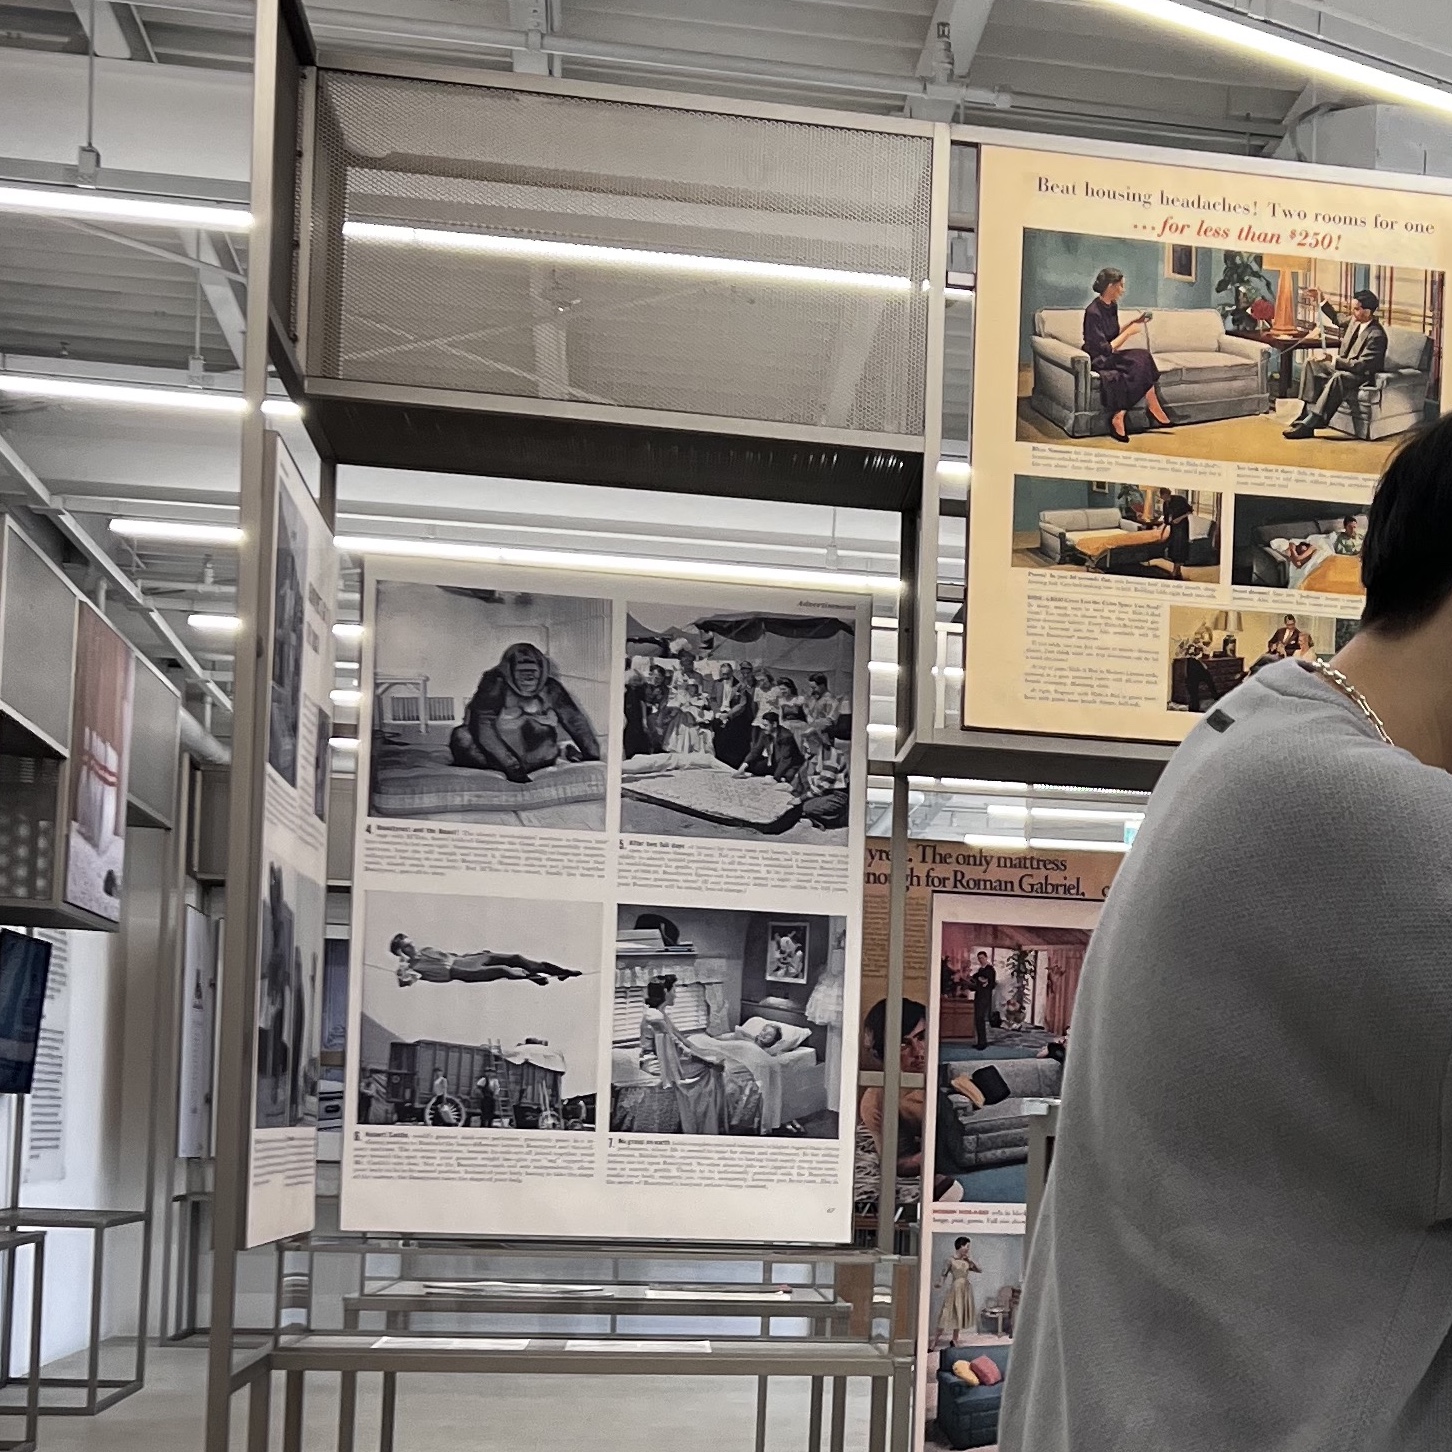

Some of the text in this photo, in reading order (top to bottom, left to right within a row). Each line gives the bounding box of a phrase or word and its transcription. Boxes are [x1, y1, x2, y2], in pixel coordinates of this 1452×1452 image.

[1036, 176, 1436, 236] Beat housing headaches! Two rooms for one
[1196, 219, 1231, 241] less
[1237, 224, 1282, 246] than
[1289, 229, 1342, 251] $250!
[916, 844, 952, 865] The
[955, 850, 994, 873] only
[997, 856, 1068, 872] mattress
[925, 867, 950, 888] for
[953, 870, 1014, 893] Roman
[1018, 874, 1086, 898] Gabriel.
